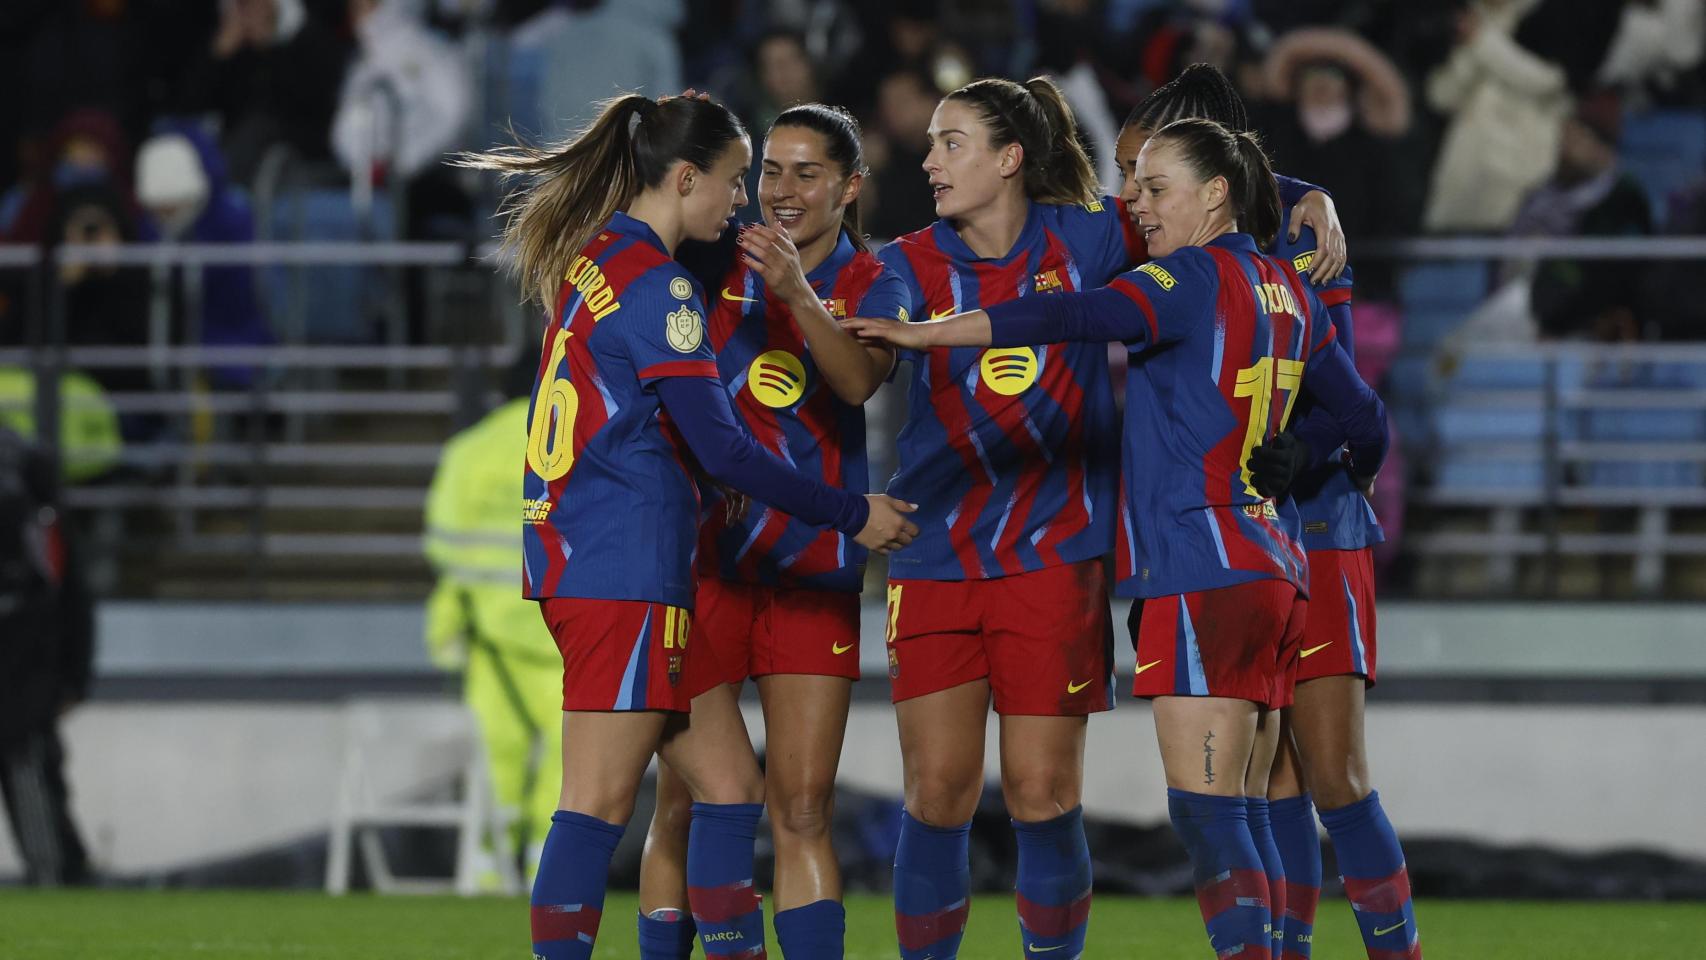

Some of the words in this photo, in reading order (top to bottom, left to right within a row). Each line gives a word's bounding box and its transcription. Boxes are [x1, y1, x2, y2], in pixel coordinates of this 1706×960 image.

[1254, 283, 1297, 317] PAJO
[526, 327, 579, 481] 6
[1234, 356, 1305, 499] 17
[704, 931, 744, 943] BARÇA
